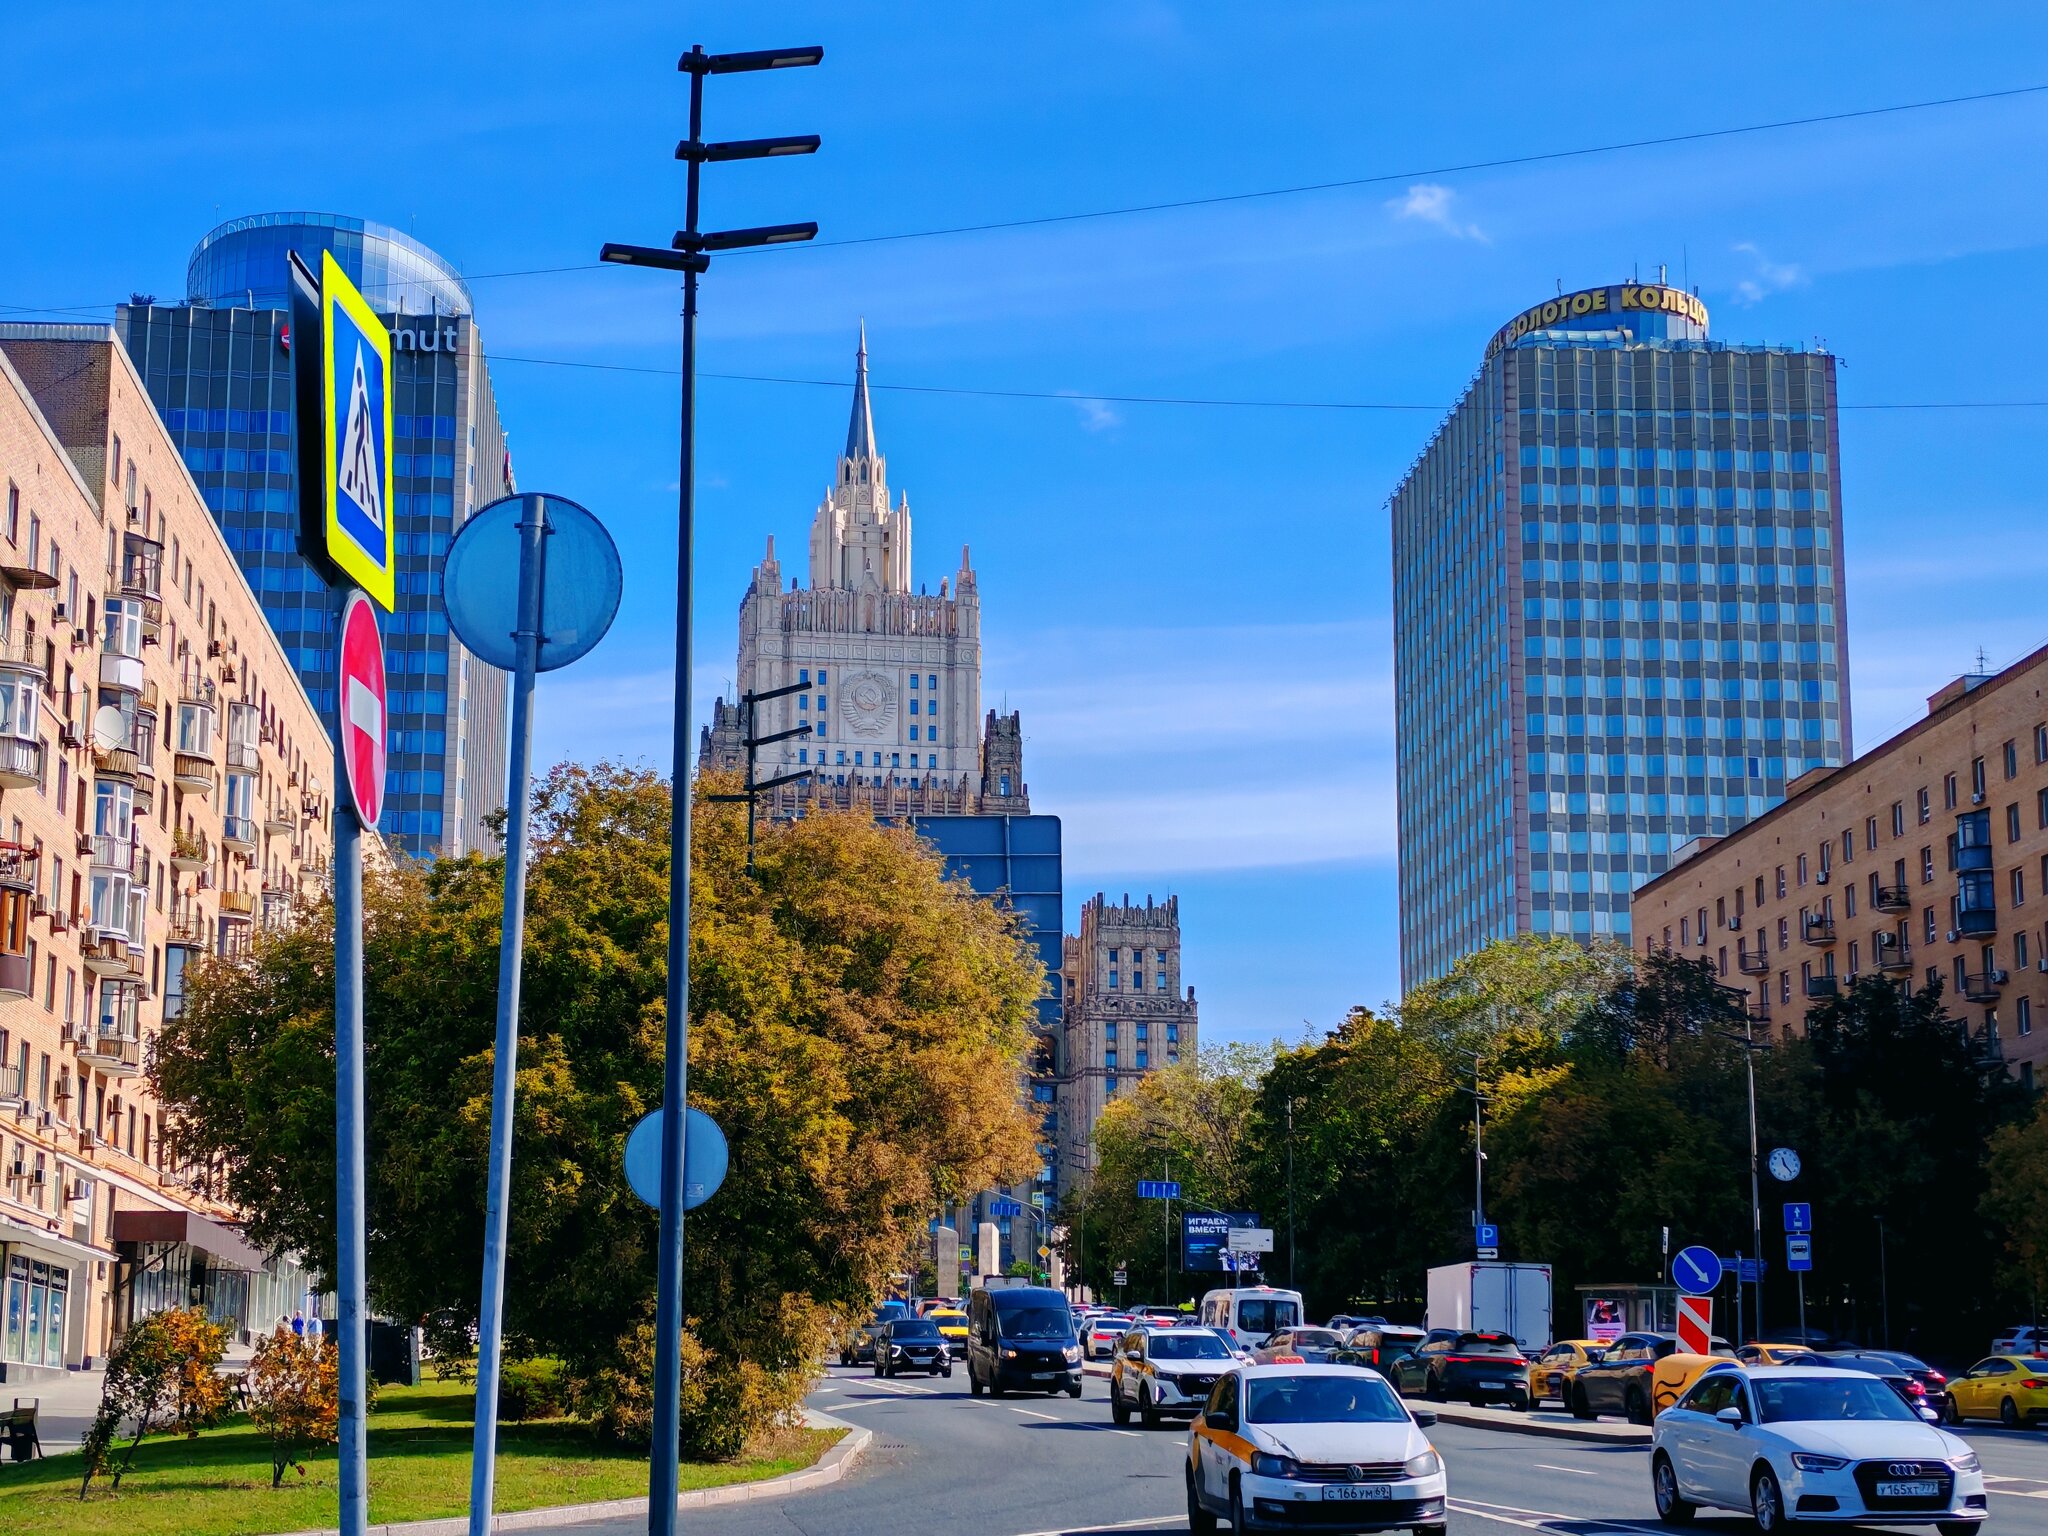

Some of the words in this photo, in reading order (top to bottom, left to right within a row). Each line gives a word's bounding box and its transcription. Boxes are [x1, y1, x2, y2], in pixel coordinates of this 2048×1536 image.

[1508, 290, 1606, 341] ЗОЛОТОЕ
[1621, 287, 1706, 326] КОЛЬЦО
[388, 326, 457, 352] mut
[1188, 1226, 1228, 1234] ВМЕСТЕ
[1482, 1227, 1494, 1244] P
